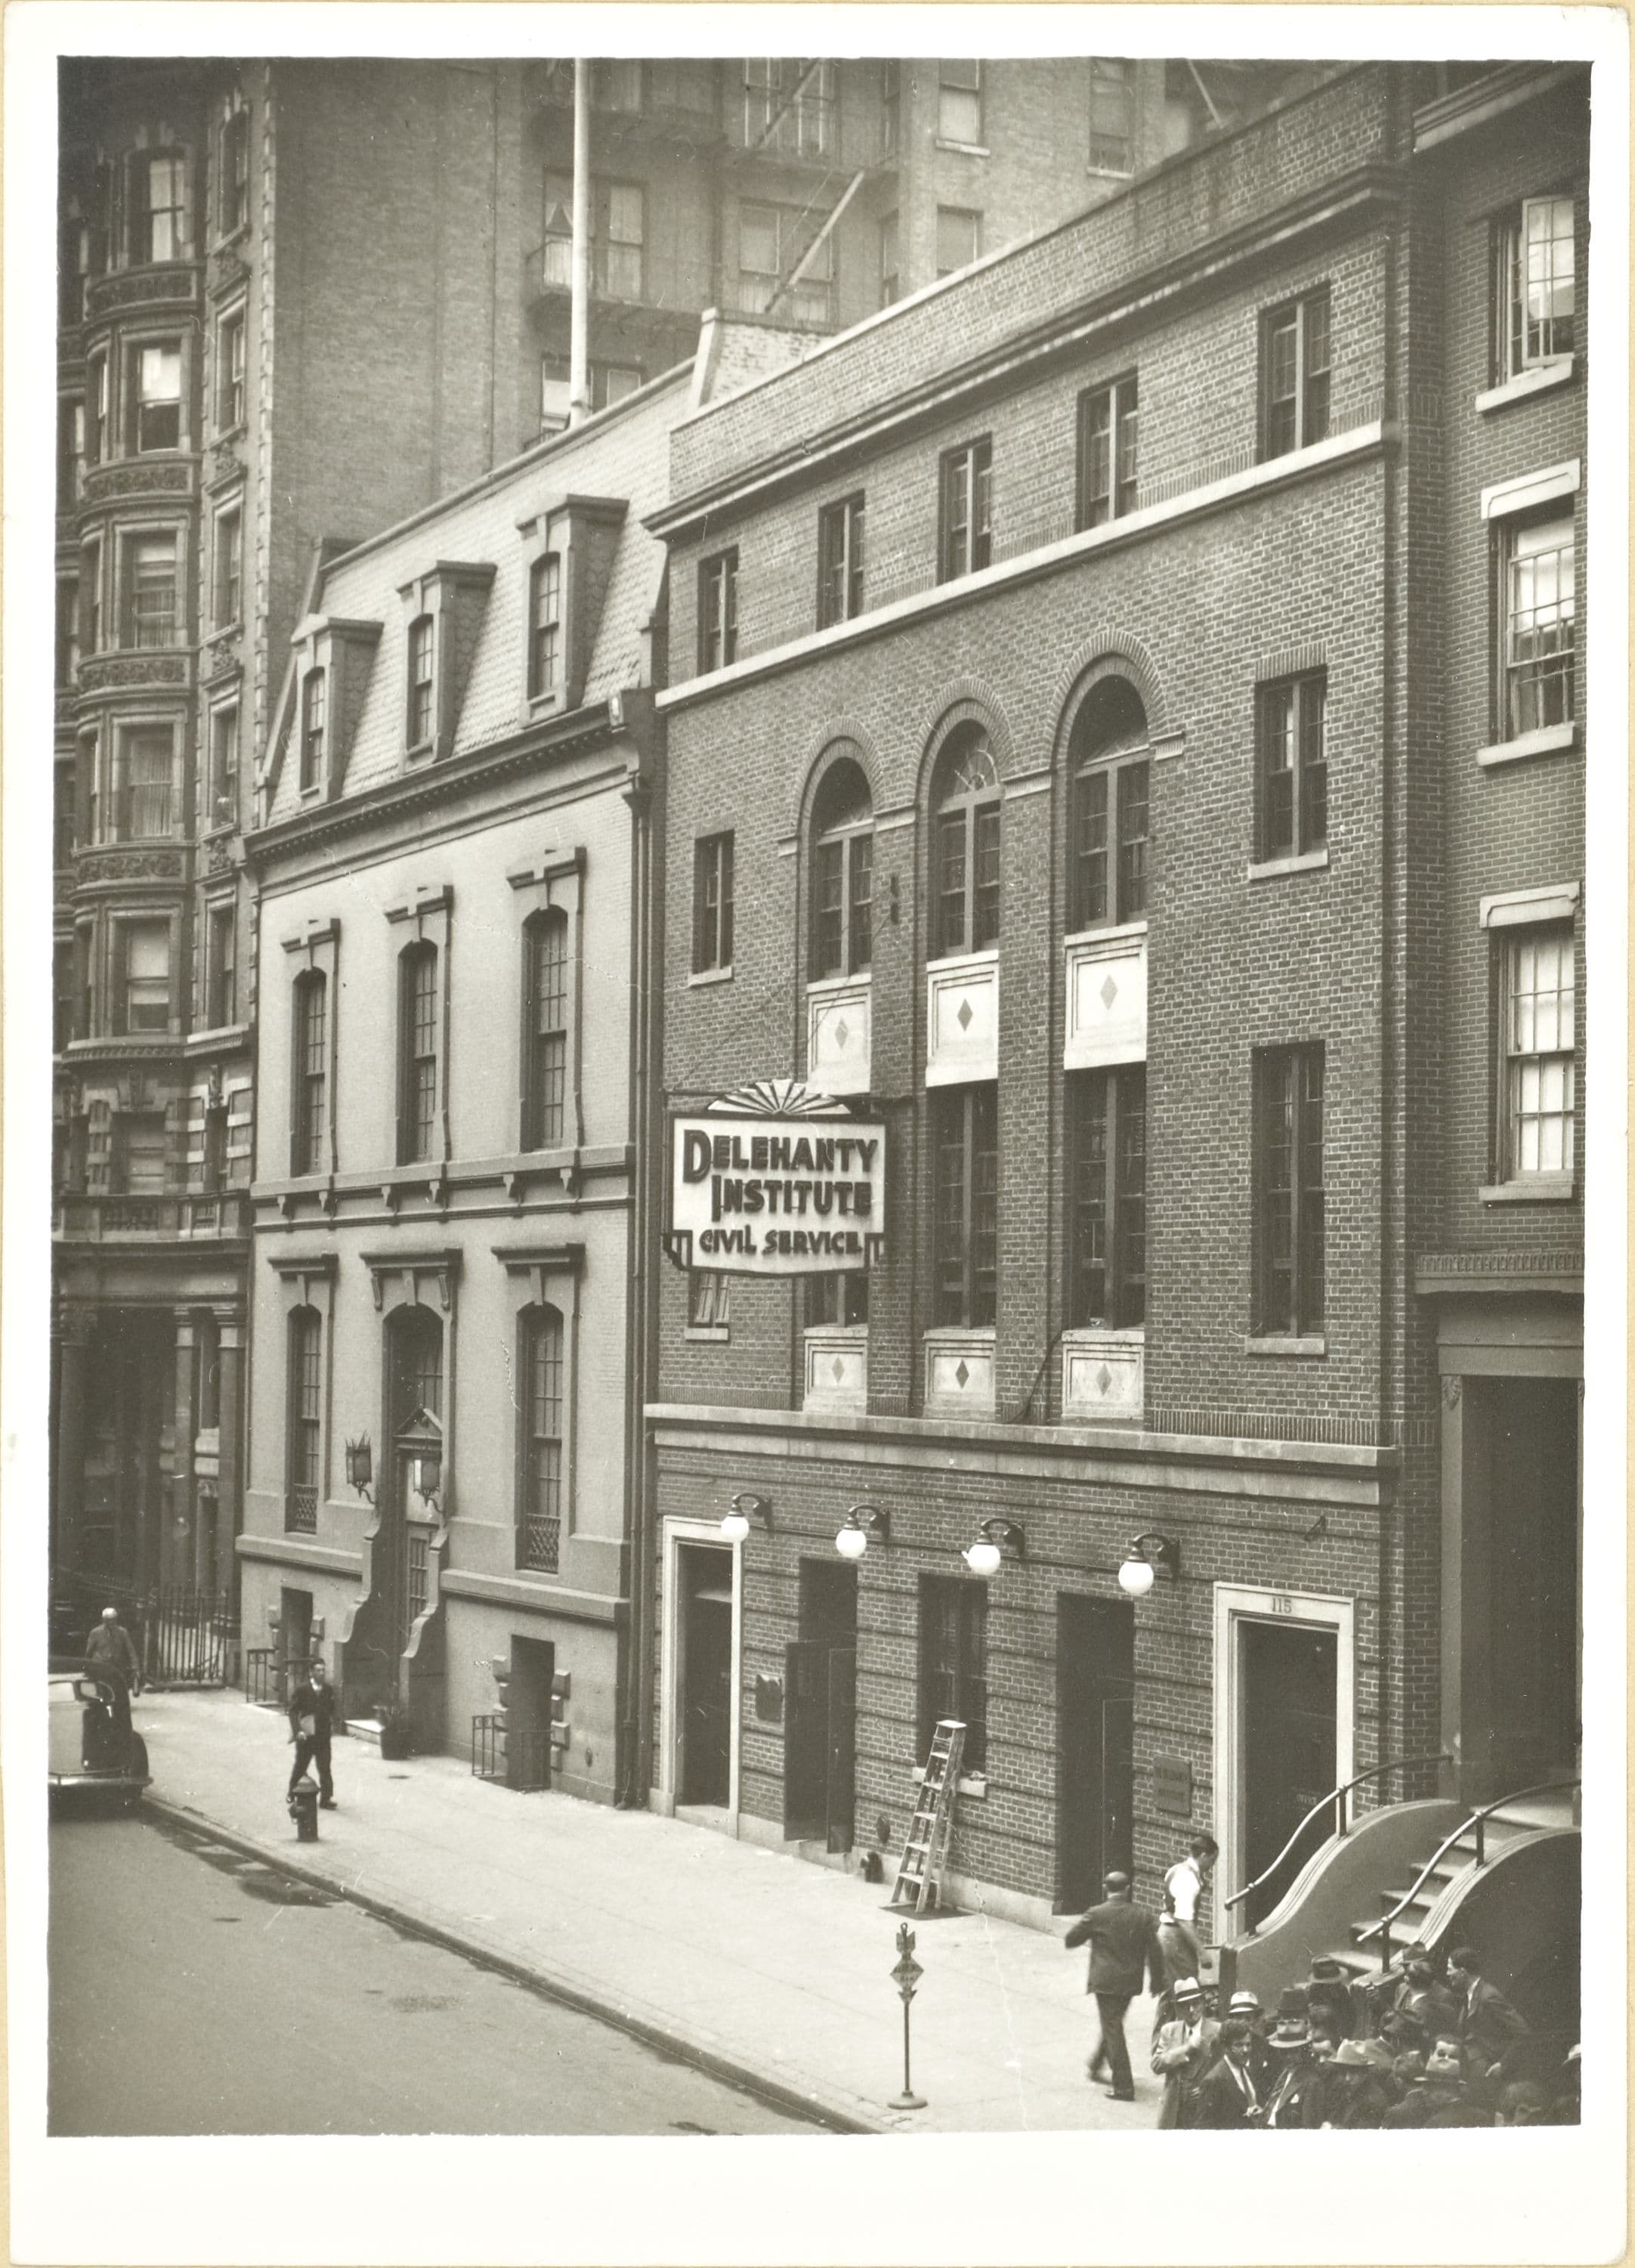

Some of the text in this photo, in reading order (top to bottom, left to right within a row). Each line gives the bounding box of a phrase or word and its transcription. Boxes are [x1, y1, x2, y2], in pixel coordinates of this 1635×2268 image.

[683, 1129, 878, 1184] DELEHANTY
[711, 1174, 872, 1222] INSTITUTE
[699, 1224, 862, 1255] CIVIL SERVICE
[1272, 1598, 1292, 1614] 115
